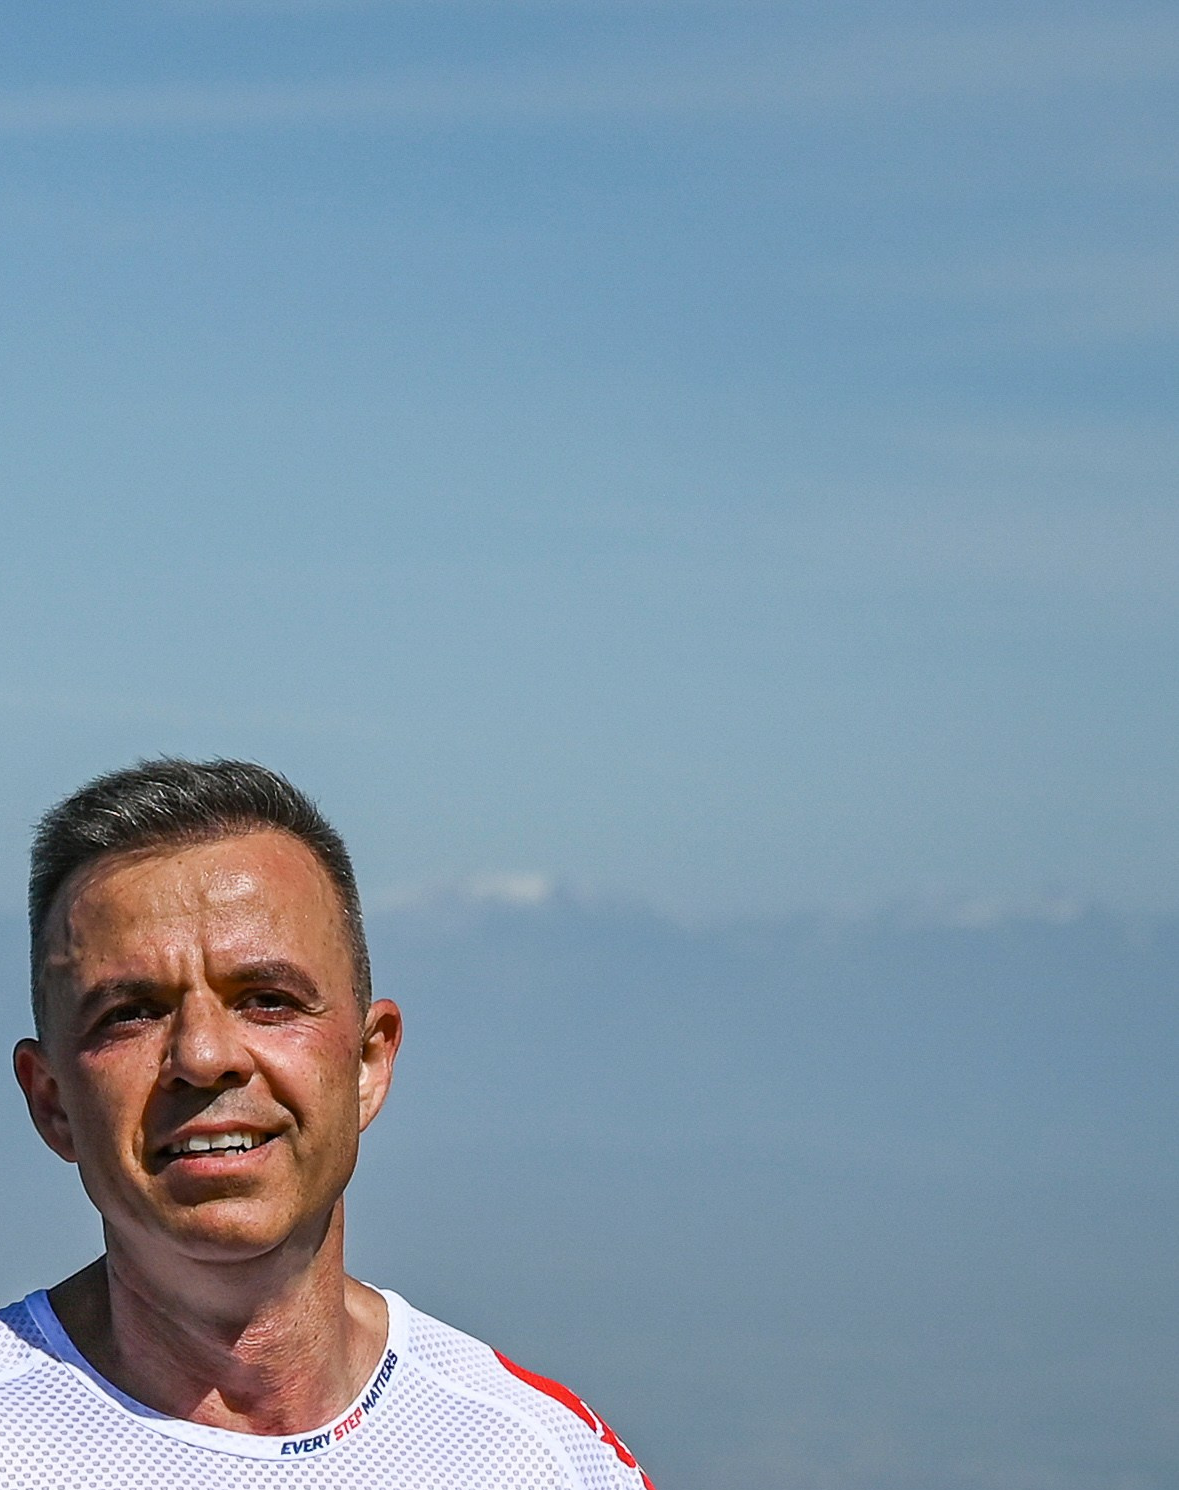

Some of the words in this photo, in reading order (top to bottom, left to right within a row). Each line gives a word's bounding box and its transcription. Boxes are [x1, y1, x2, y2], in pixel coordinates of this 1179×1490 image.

[281, 1431, 331, 1455] EVERY
[333, 1407, 363, 1441] STEP
[361, 1349, 398, 1415] MATTERS
